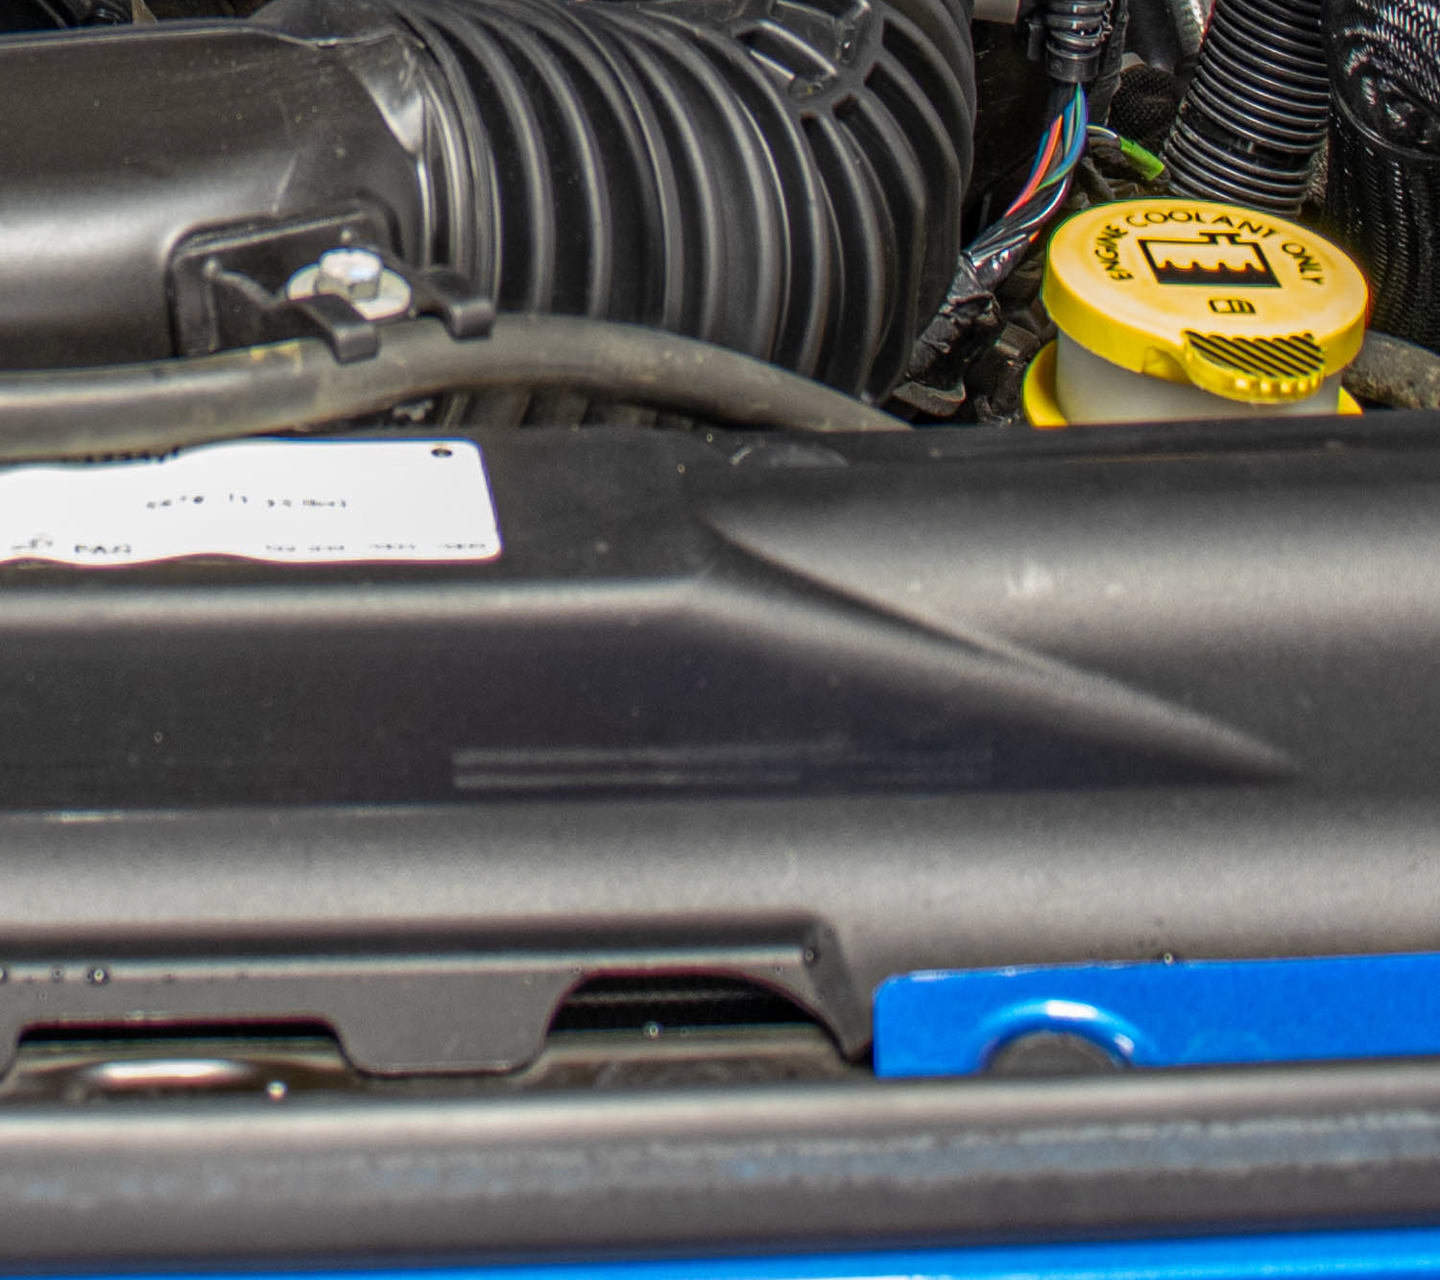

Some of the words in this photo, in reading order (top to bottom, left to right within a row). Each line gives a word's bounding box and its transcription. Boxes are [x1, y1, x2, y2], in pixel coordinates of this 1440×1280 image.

[1095, 223, 1134, 281] ENGINE
[1126, 210, 1278, 238] COOLANT
[1282, 241, 1324, 285] ONLY
